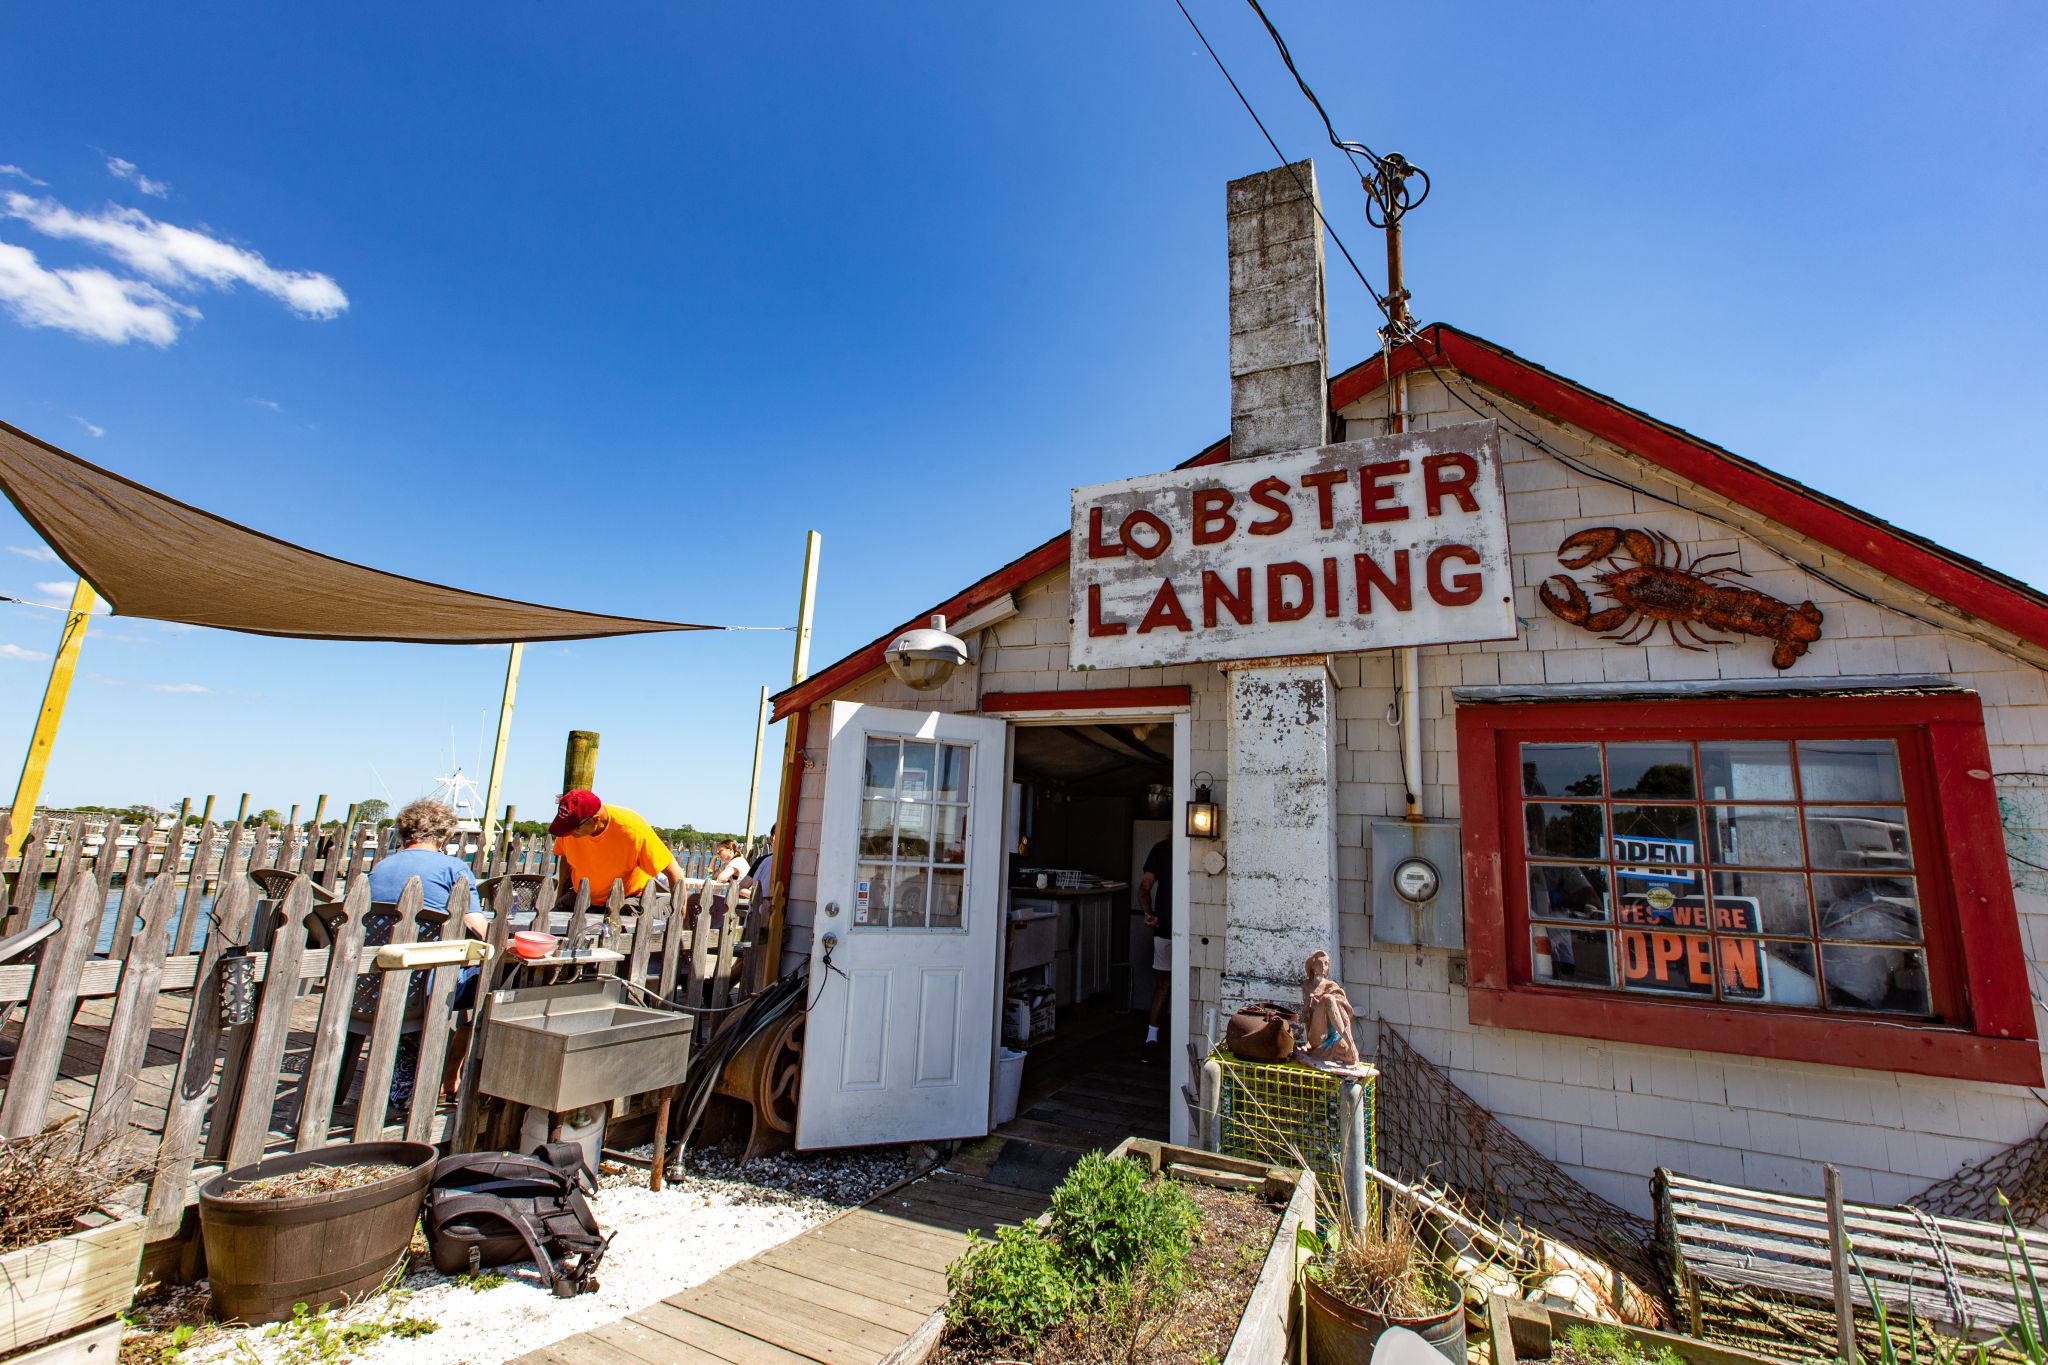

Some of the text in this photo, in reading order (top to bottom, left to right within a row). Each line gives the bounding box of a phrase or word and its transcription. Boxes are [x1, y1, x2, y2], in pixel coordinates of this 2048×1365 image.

[1088, 452, 1480, 560] LOBSTER
[1088, 544, 1483, 637] LANDING
[1612, 839, 1688, 877] OPEN
[1672, 906, 1748, 929] WERE
[1622, 931, 1759, 989] OPEN
